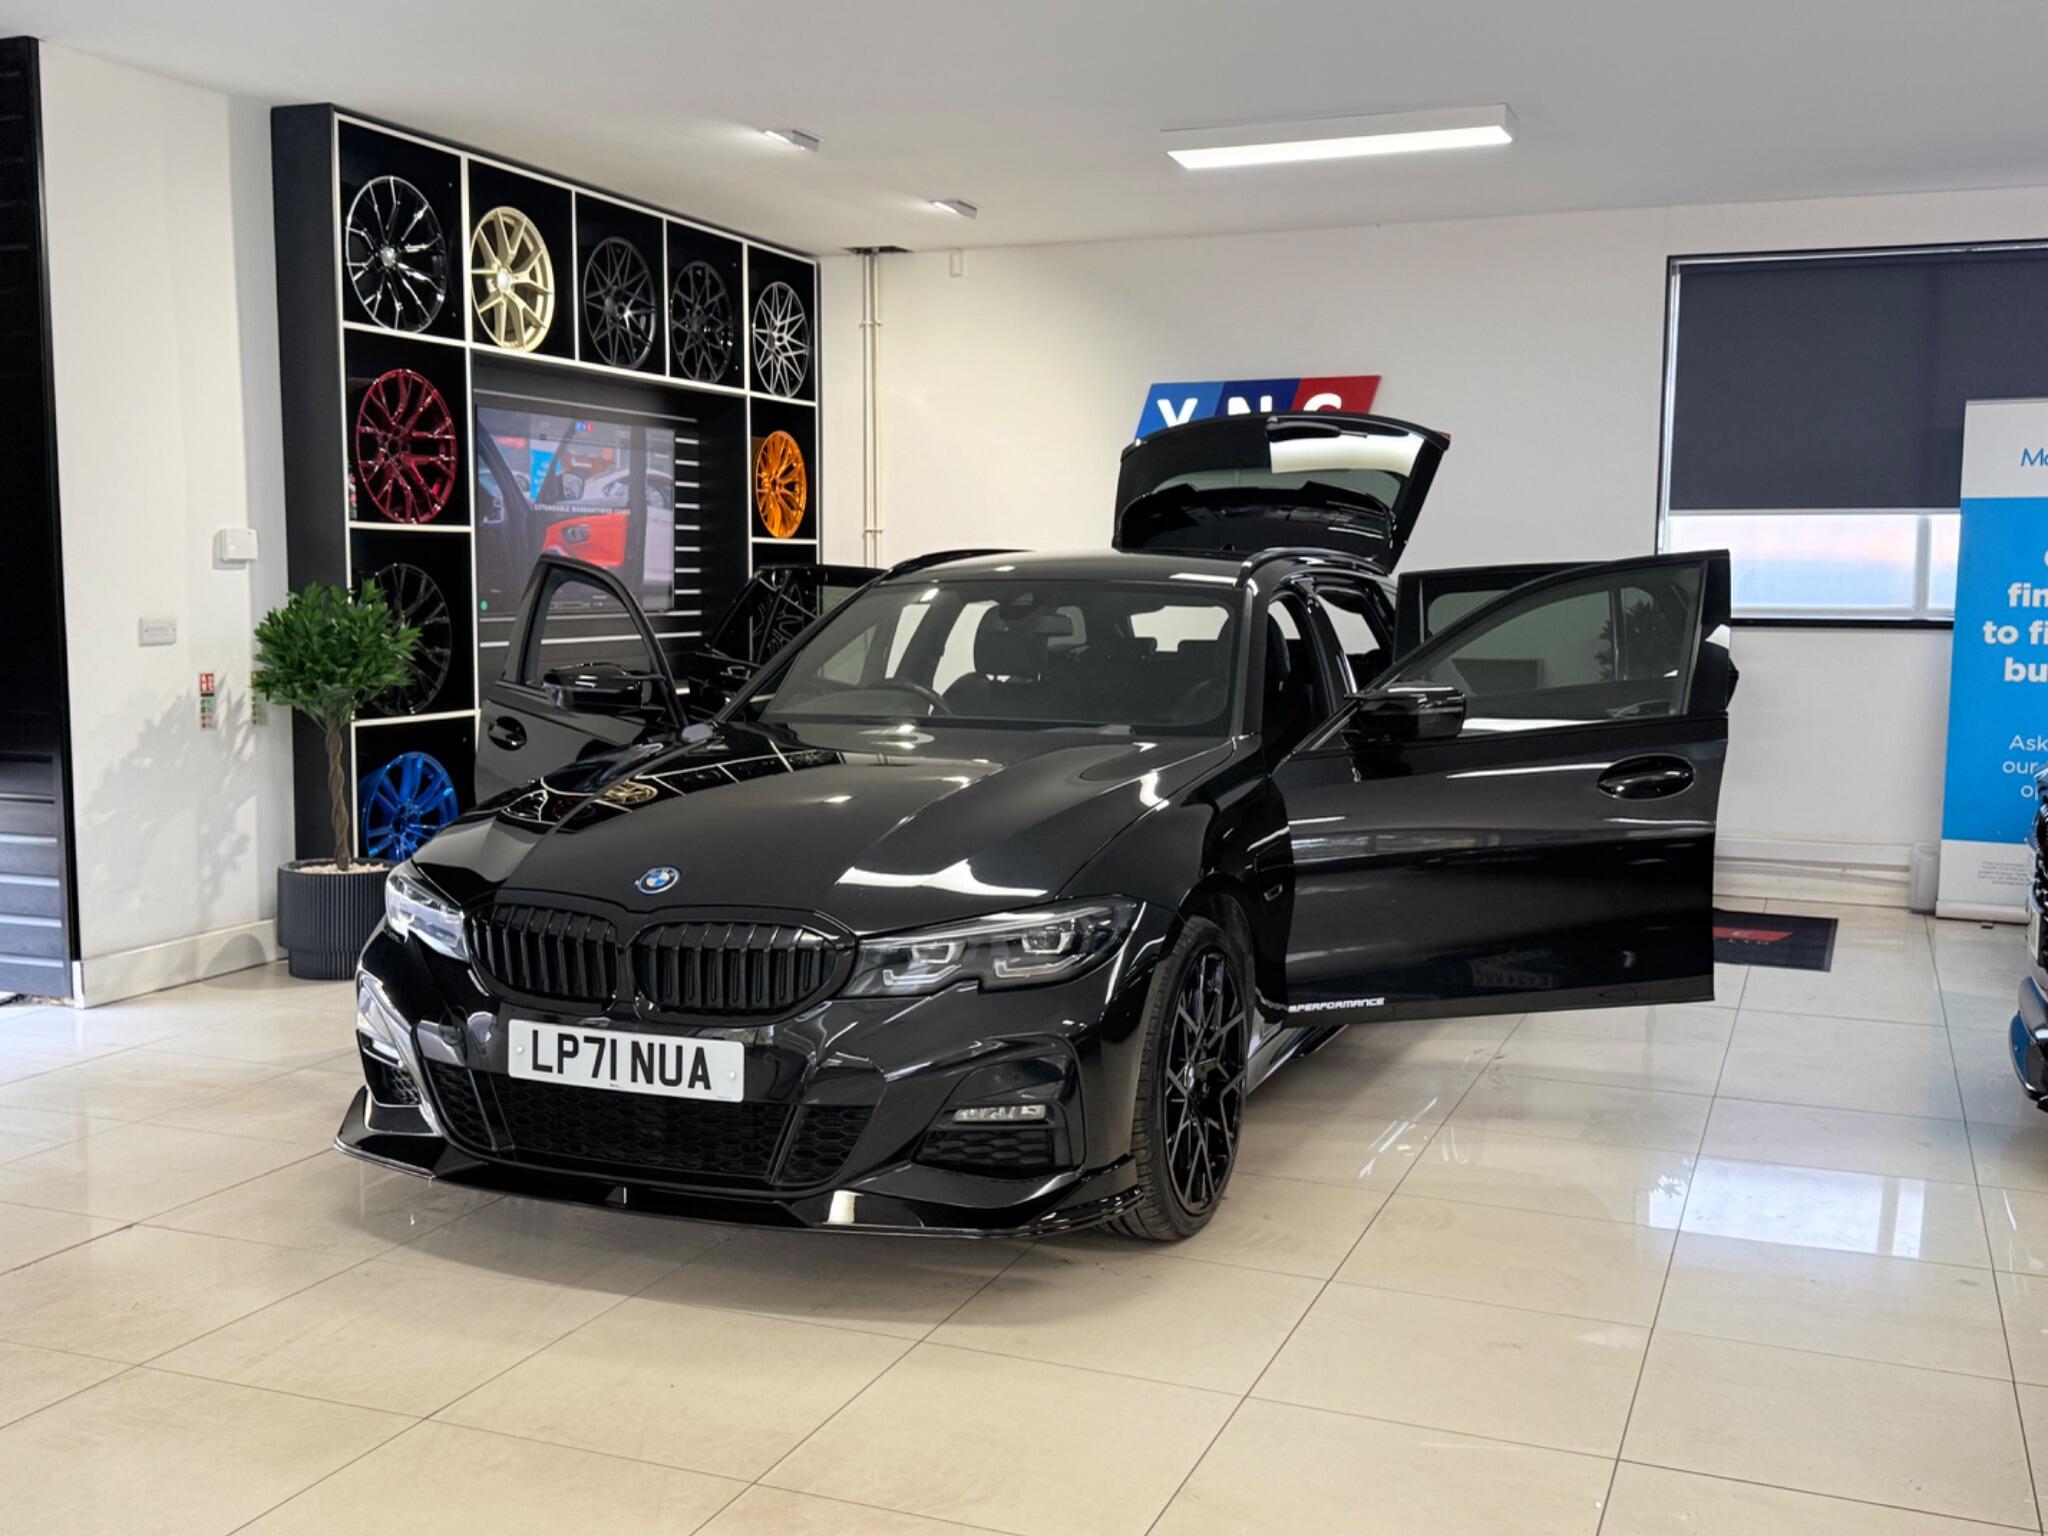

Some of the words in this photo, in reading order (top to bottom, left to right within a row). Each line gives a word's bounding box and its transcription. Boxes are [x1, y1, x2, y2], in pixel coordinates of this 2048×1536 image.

[1982, 621, 2019, 645] to
[2004, 656, 2048, 682] bu
[2008, 734, 2048, 751] Ask
[2002, 760, 2039, 774] our
[532, 1030, 617, 1081] LP71
[630, 1040, 712, 1090] NUA
